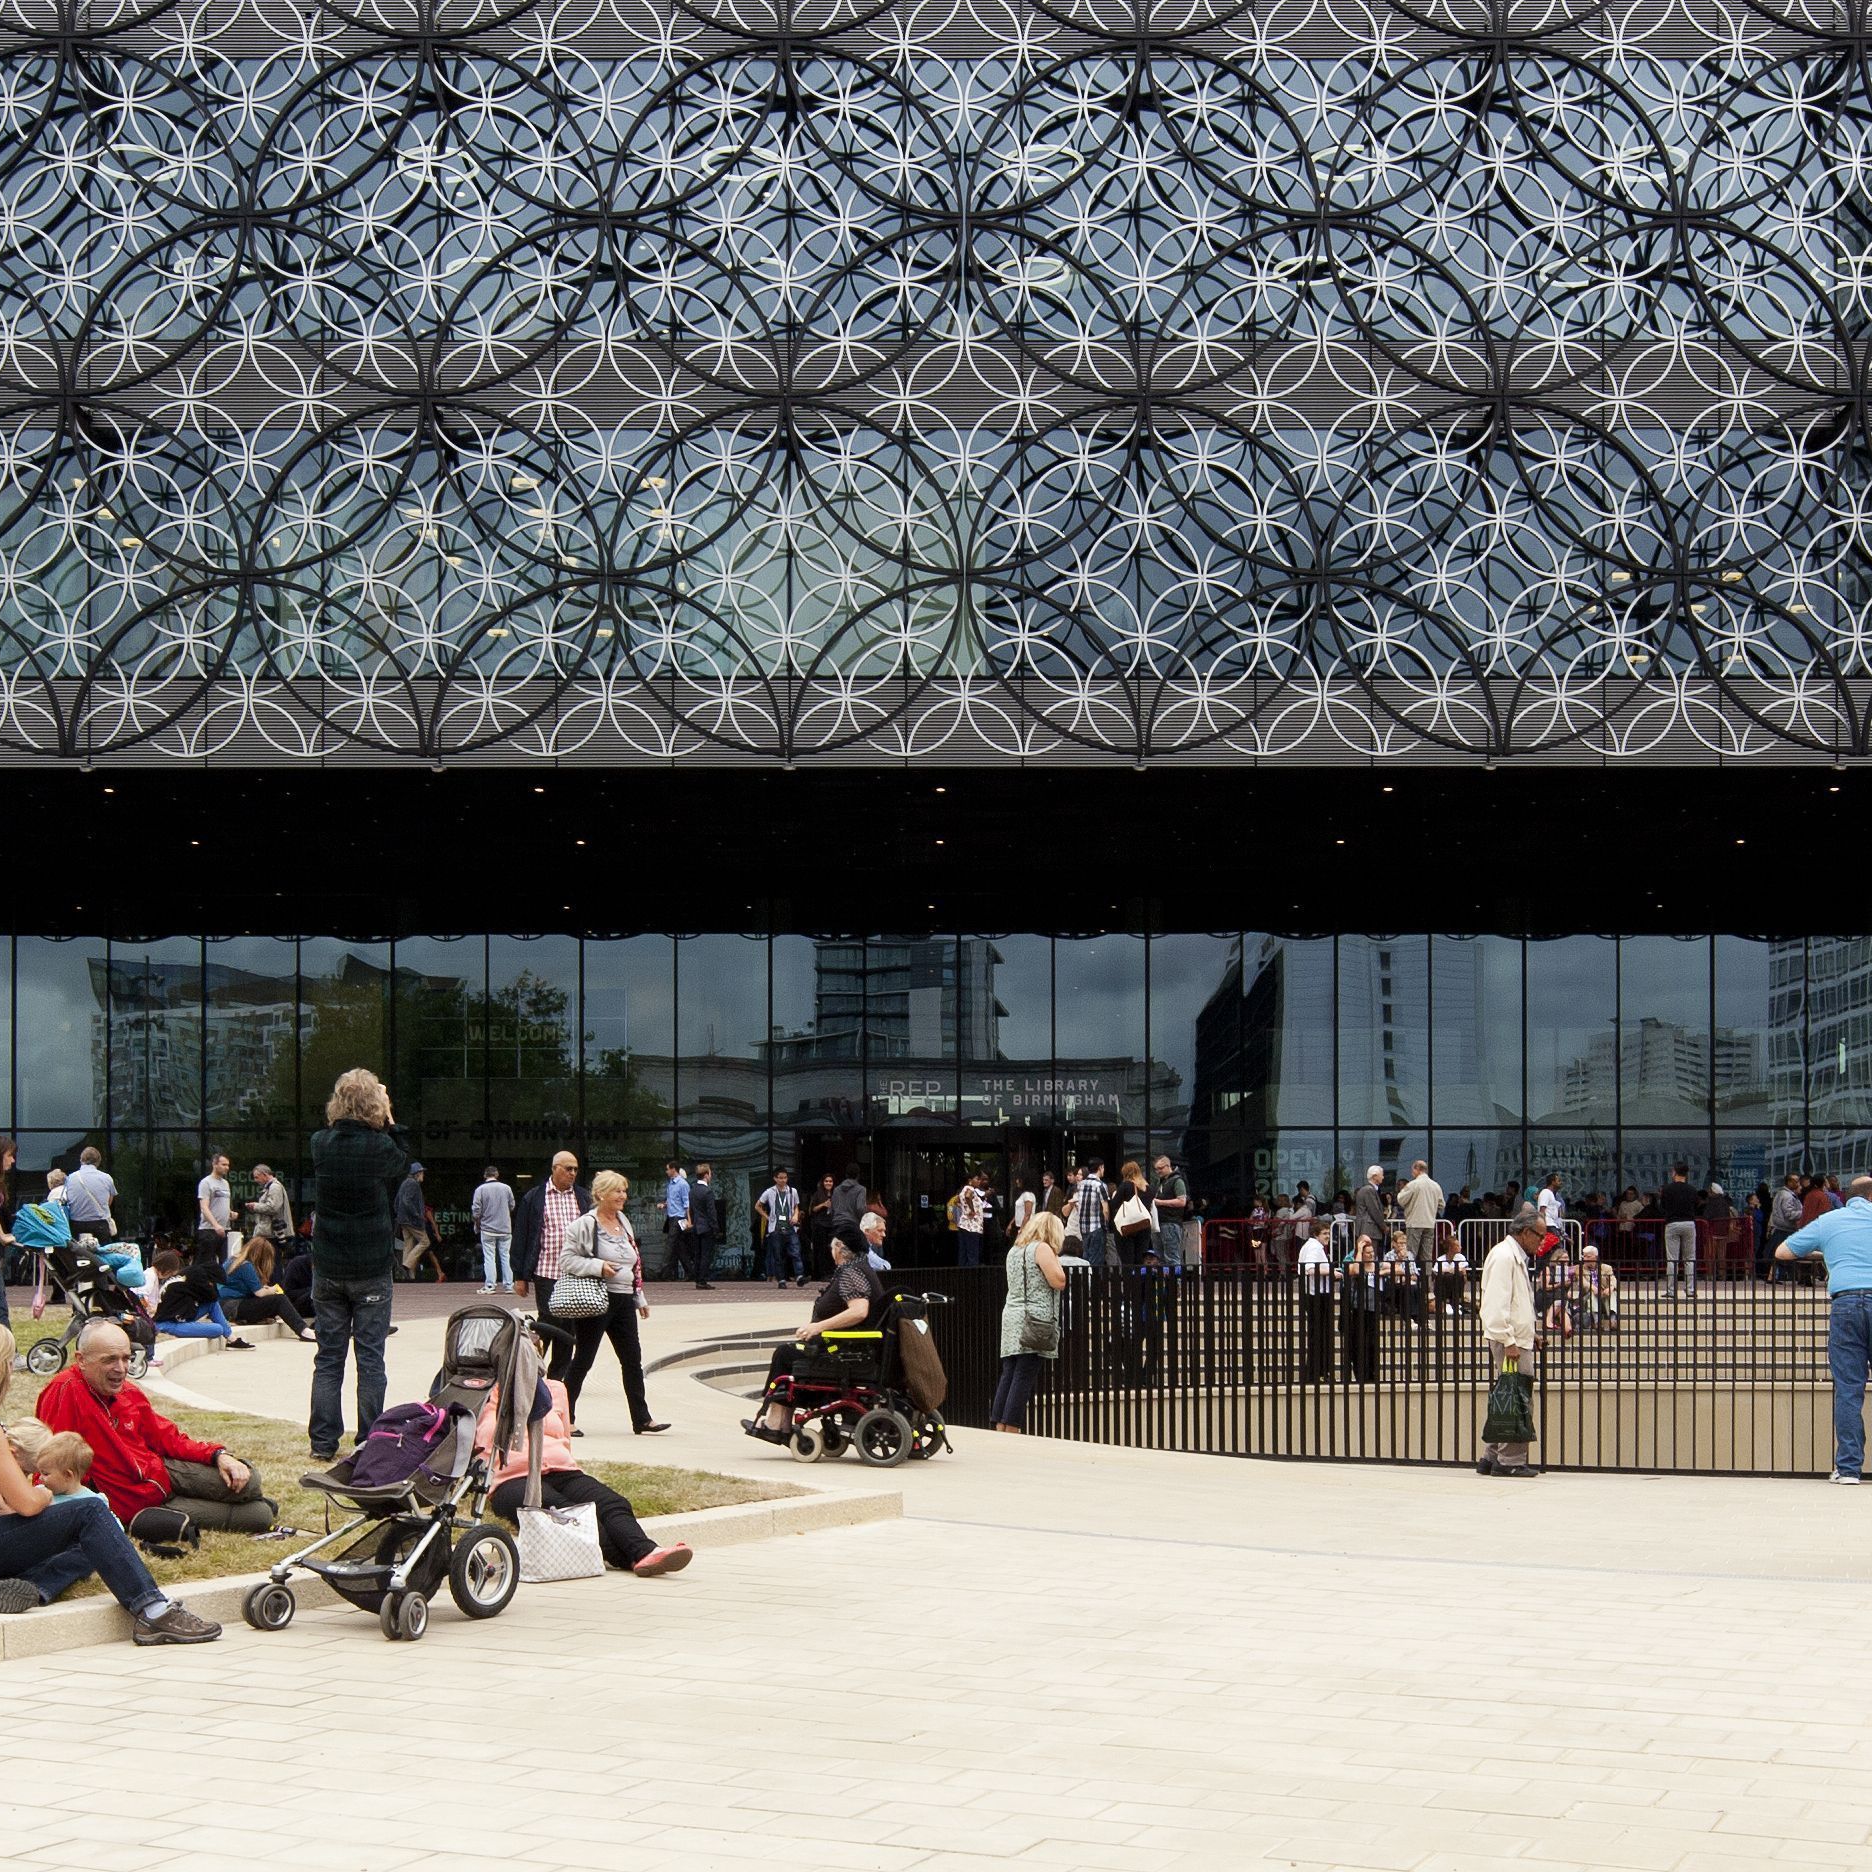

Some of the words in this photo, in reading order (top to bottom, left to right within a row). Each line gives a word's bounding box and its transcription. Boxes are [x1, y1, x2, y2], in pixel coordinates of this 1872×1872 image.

[890, 1081, 941, 1099] REP
[982, 1080, 1015, 1091] THE
[1025, 1080, 1099, 1091] LIBRARY
[982, 1094, 1003, 1106] OF
[1013, 1094, 1119, 1106] BIRMINGHAM
[1534, 1144, 1605, 1156] DISCOVERY
[1254, 1149, 1322, 1170] OPEN
[1534, 1157, 1585, 1169] SEASON
[1721, 1168, 1759, 1178] YOUNG
